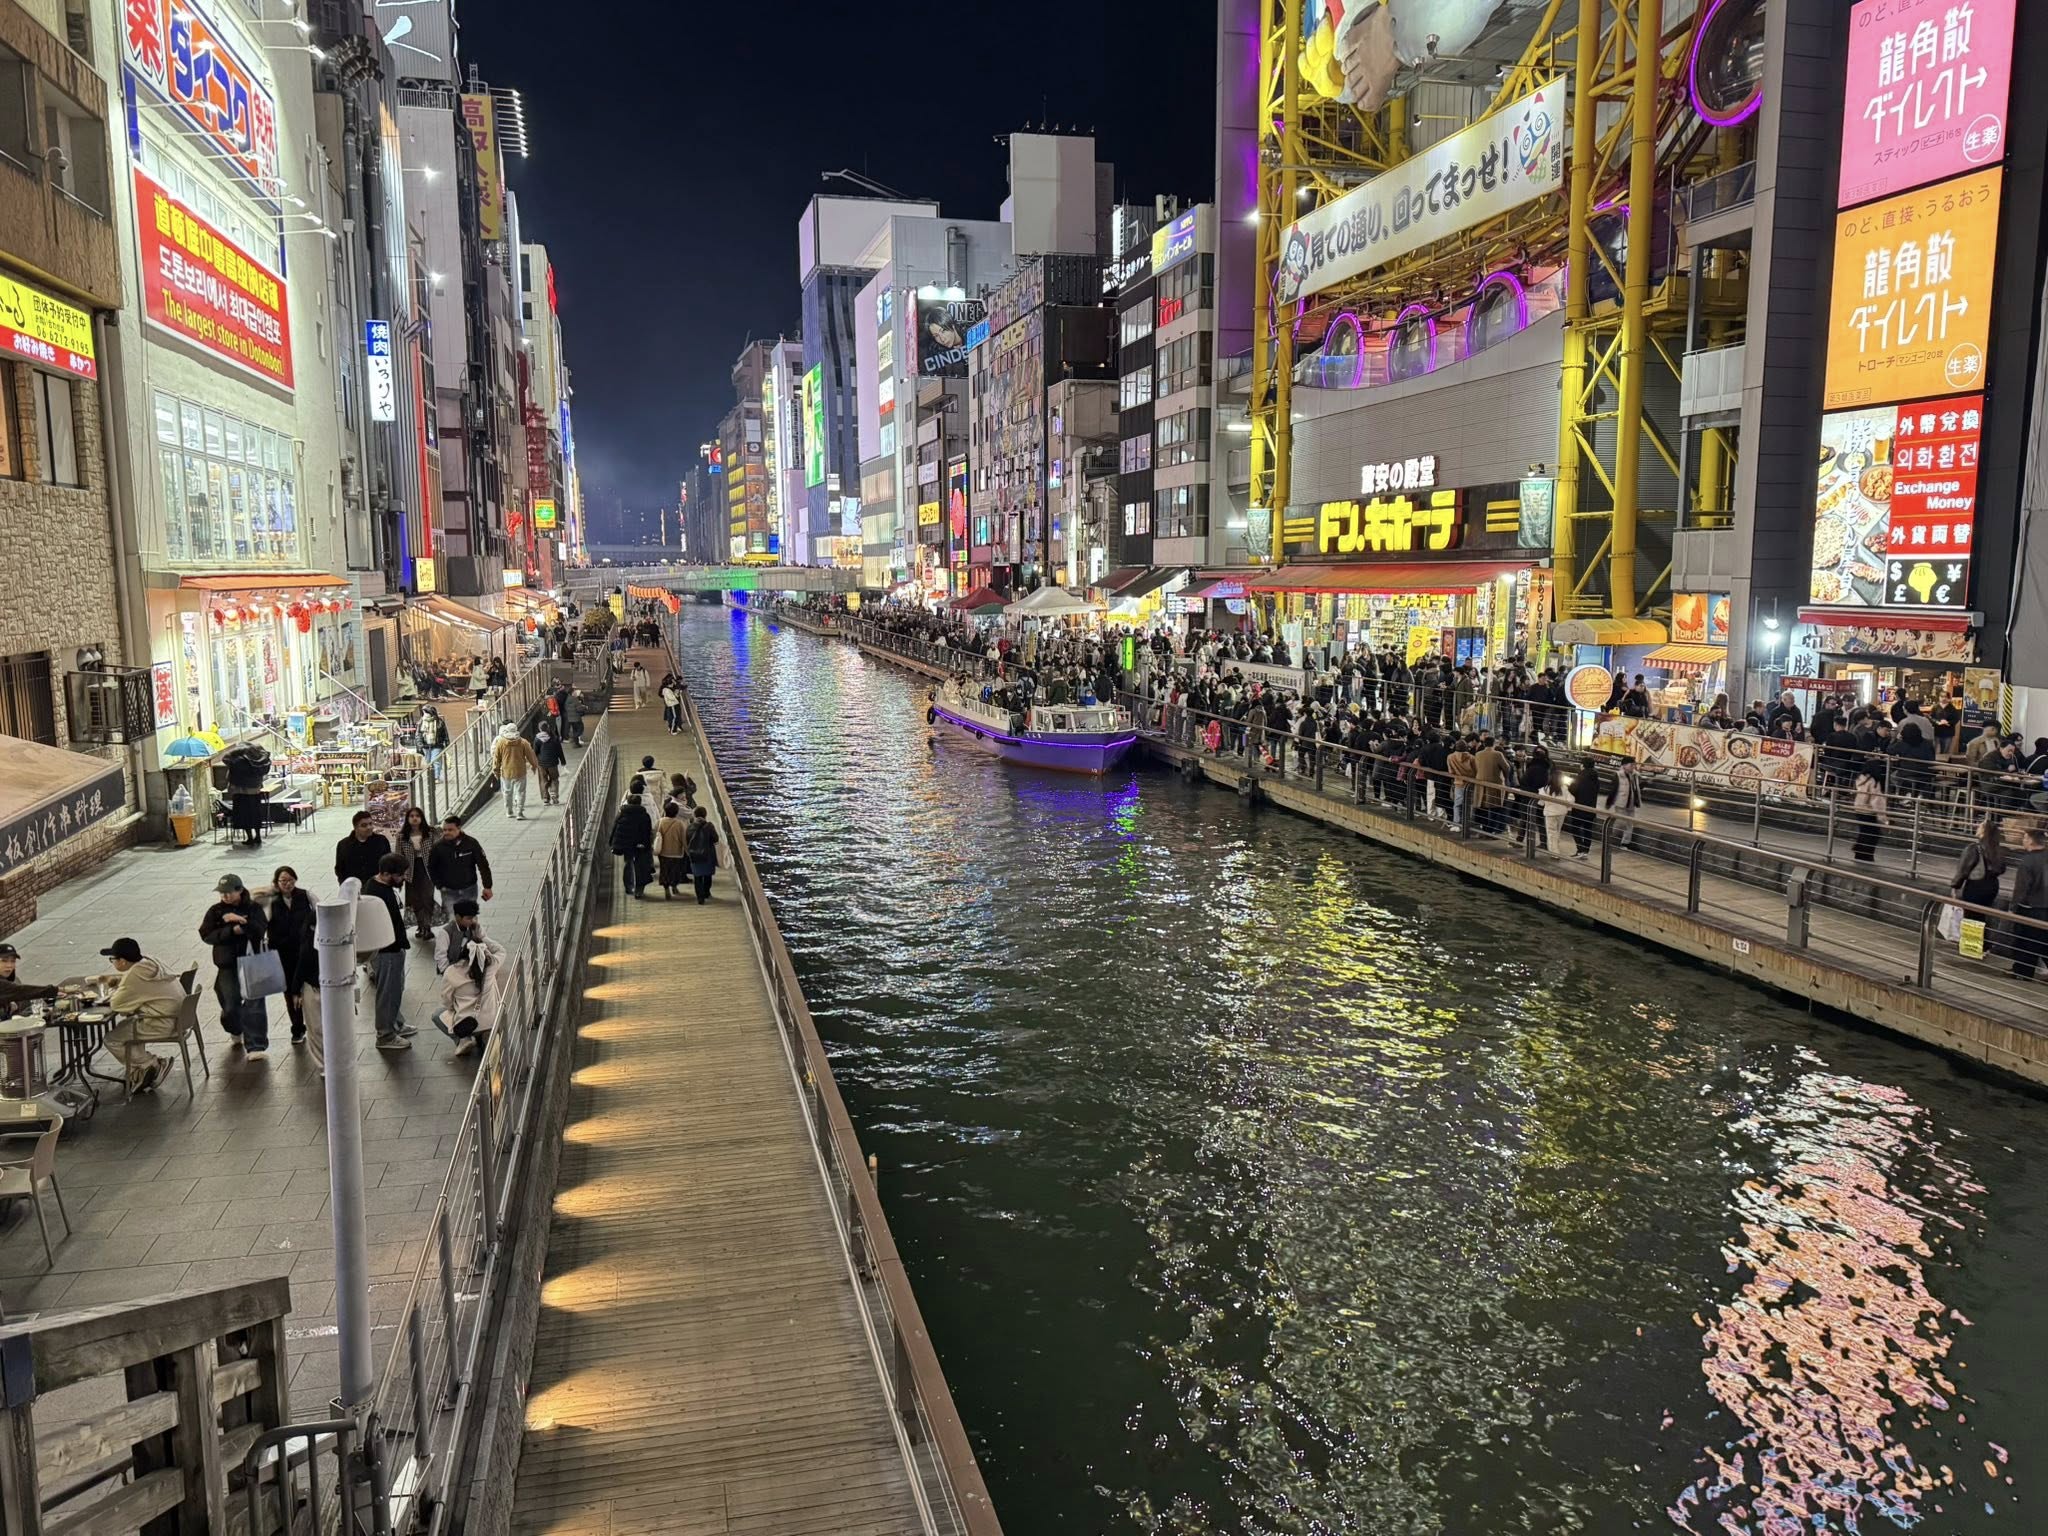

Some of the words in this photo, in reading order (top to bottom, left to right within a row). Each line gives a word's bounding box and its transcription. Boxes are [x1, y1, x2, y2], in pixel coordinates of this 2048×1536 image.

[1878, 1, 1974, 88] 龍角散
[170, 5, 251, 153] ダイコク
[1863, 63, 1988, 144] ダイレクト
[1873, 139, 1920, 166] スティック
[1966, 125, 1999, 150] 生薬
[1844, 185, 1990, 238] のど、直接、うるおう
[159, 244, 228, 316] 도톤보리에서
[1863, 229, 1955, 299] 龍角散
[33, 295, 86, 331] 団体予約受付中
[162, 288, 183, 323] The
[184, 303, 216, 340] largest
[217, 322, 240, 351] store
[240, 333, 249, 356] in
[1848, 289, 1969, 352] ダイレクト
[13, 333, 56, 362] お好み焼き
[70, 353, 92, 373] 串かつ
[371, 324, 389, 355] 焼肉
[1858, 356, 1895, 373] トローチ
[1948, 355, 1978, 375] 生薬
[375, 358, 393, 419] いろりや
[1899, 409, 1980, 436] 外幣兌換
[1361, 455, 1436, 494] 驚安の殿堂
[1896, 441, 1978, 471] 외화환전
[1894, 480, 1960, 496] Exchange
[1926, 496, 1973, 511] Money
[1890, 523, 1971, 545] 外貨両替
[1793, 653, 1816, 676] 勝
[0, 789, 103, 868] 板創作串料理
